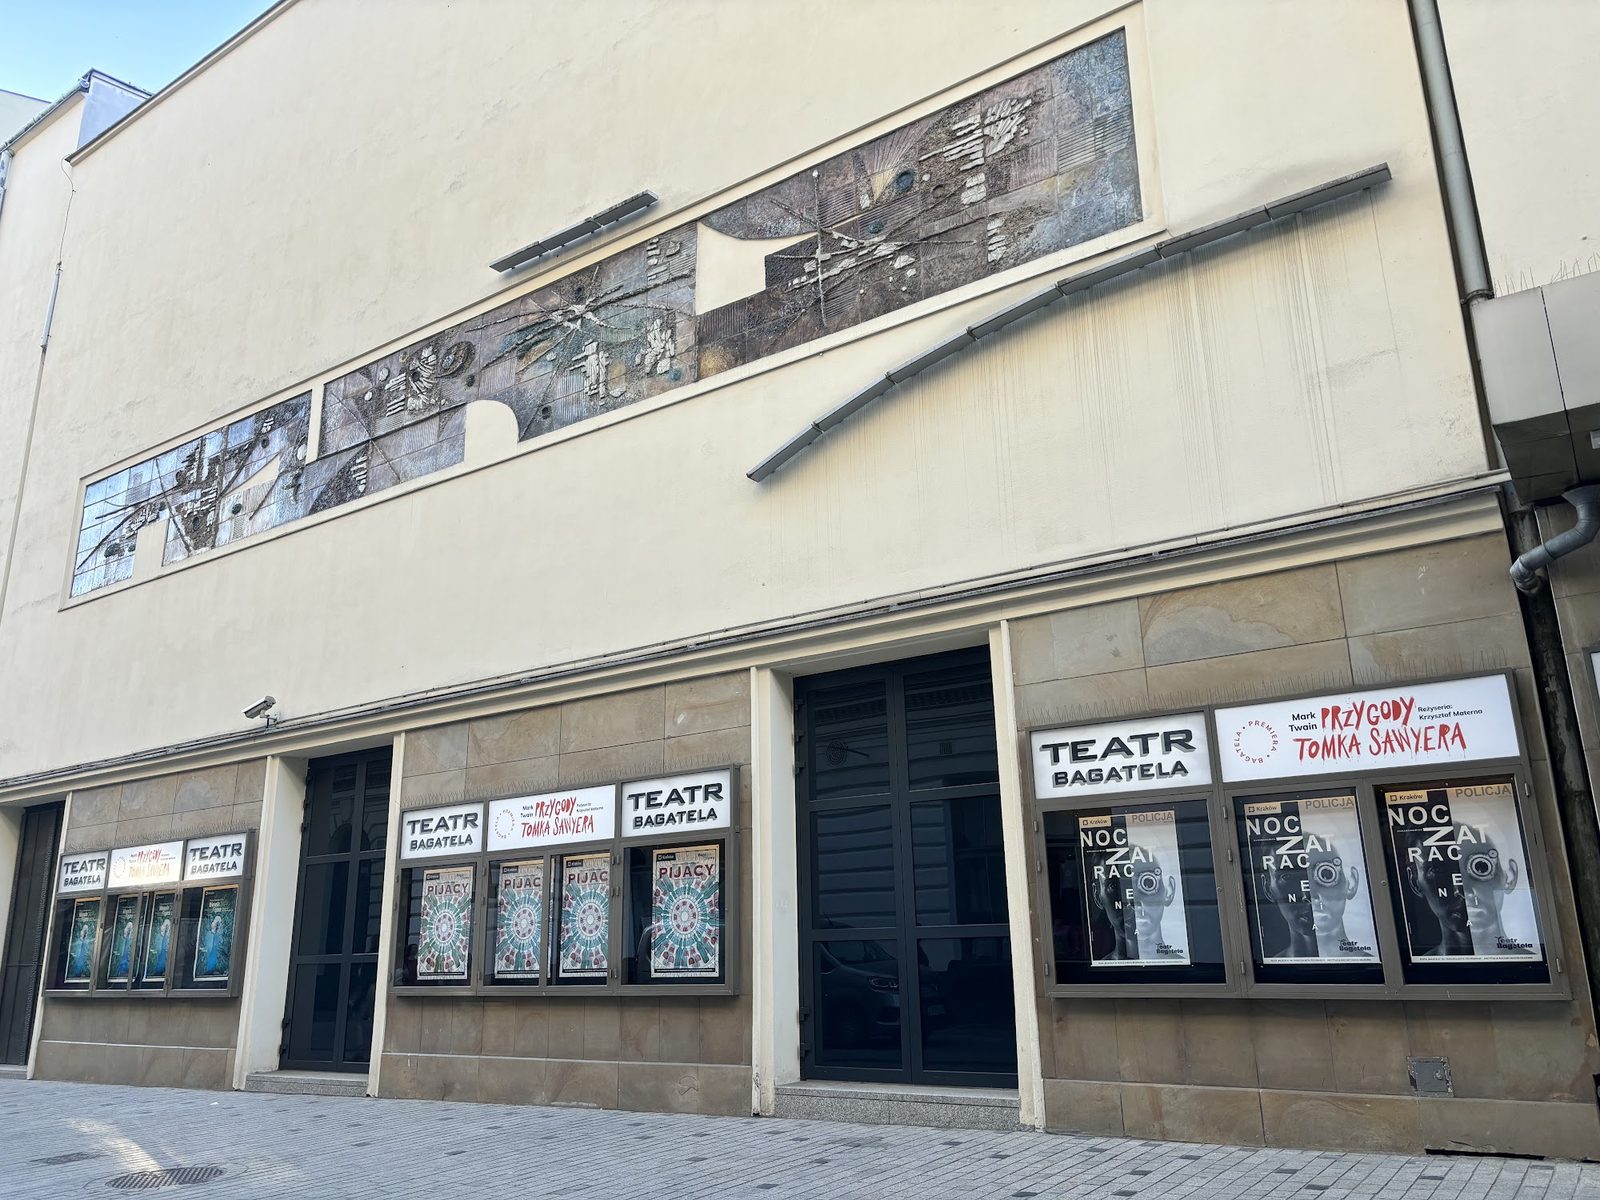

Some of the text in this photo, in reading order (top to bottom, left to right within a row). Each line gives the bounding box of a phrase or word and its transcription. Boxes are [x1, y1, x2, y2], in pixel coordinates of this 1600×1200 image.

[1292, 712, 1316, 721] Mark
[1321, 696, 1414, 731] PRZYGODY
[1418, 704, 1453, 712] Reżyseria:
[1419, 708, 1483, 720] Krzysztof Materna
[1288, 722, 1318, 732] Twain
[1248, 720, 1278, 752] PREMIERA
[1292, 722, 1467, 760] TOMKA SAWYERA
[1040, 729, 1197, 766] TEATR
[1052, 760, 1189, 788] BAGATELA
[626, 782, 724, 812] TEATR
[1455, 784, 1512, 798] POLICJA
[534, 796, 576, 818] PRZYGODY
[1306, 798, 1354, 810] POLICJA
[632, 808, 718, 830] BAGATELA
[1132, 812, 1174, 824] POLICJA
[1388, 804, 1450, 826] NOC
[406, 812, 478, 836] TEATR
[521, 820, 550, 838] TOMKA
[553, 814, 594, 836] SAWYERA
[1246, 816, 1300, 836] NOC
[409, 834, 474, 852] BAGATELA
[1080, 828, 1126, 847] NOC
[189, 842, 242, 862] TEATR
[1408, 844, 1462, 862] RAC
[64, 858, 106, 875] TEATR
[191, 860, 238, 876] BAGATELA
[1262, 854, 1310, 870] RAC
[568, 871, 608, 884] PIJAC
[659, 864, 714, 879] PIJACY
[1094, 864, 1135, 879] RAC
[64, 874, 100, 888] BAGATELA
[427, 882, 469, 896] PIJACY
[504, 877, 541, 890] PIJAC
